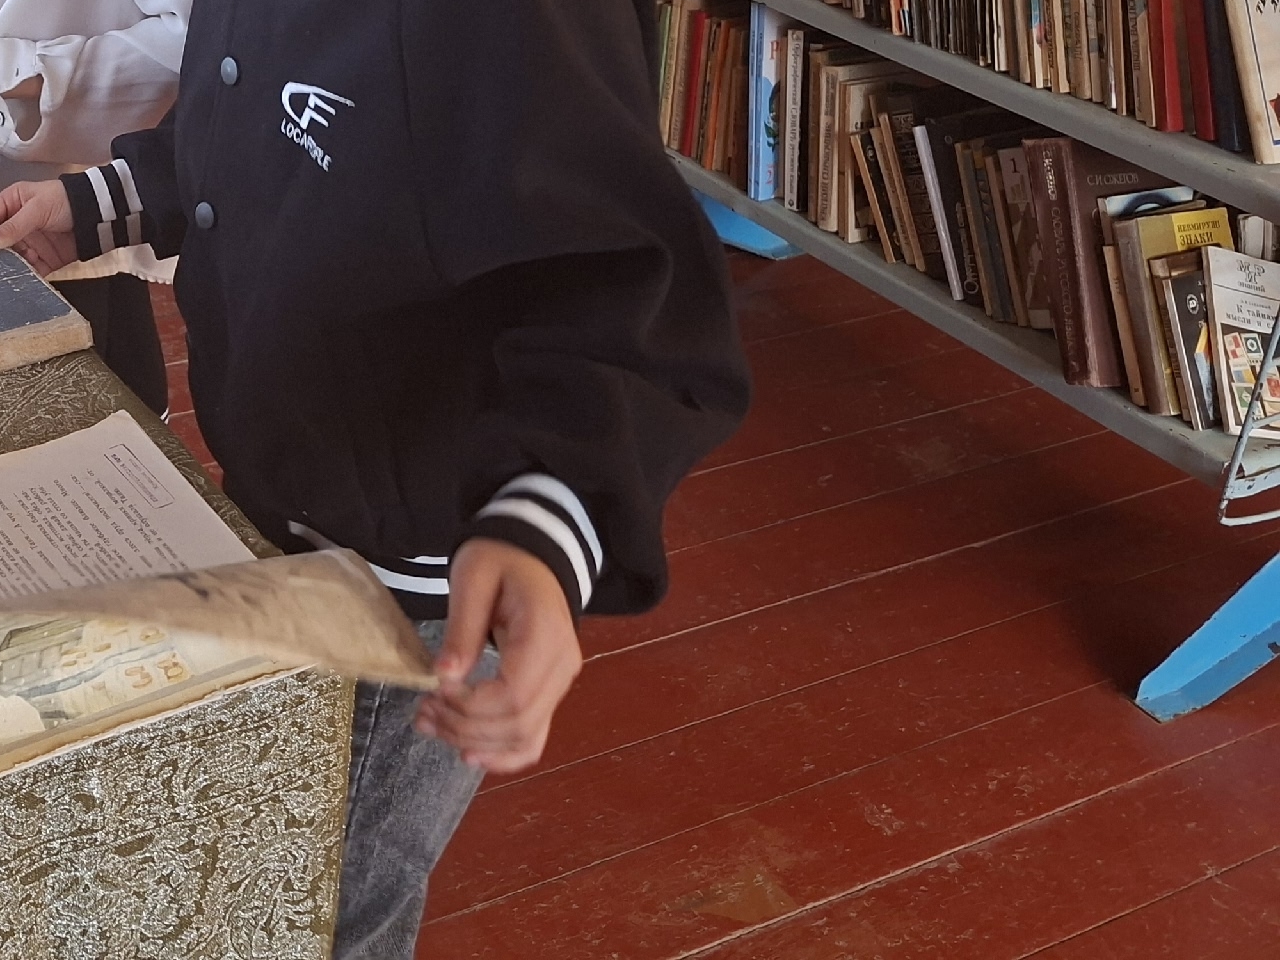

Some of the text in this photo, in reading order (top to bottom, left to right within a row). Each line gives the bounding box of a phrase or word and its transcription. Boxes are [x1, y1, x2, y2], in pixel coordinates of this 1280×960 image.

[789, 107, 797, 141] СЛОВАРЬ
[1179, 232, 1214, 246] ЗНАКИ
[1236, 304, 1244, 314] К
[28, 484, 47, 506] работу
[6, 511, 16, 522] что
[64, 531, 83, 553] сейчас
[88, 519, 112, 549] глубокое
